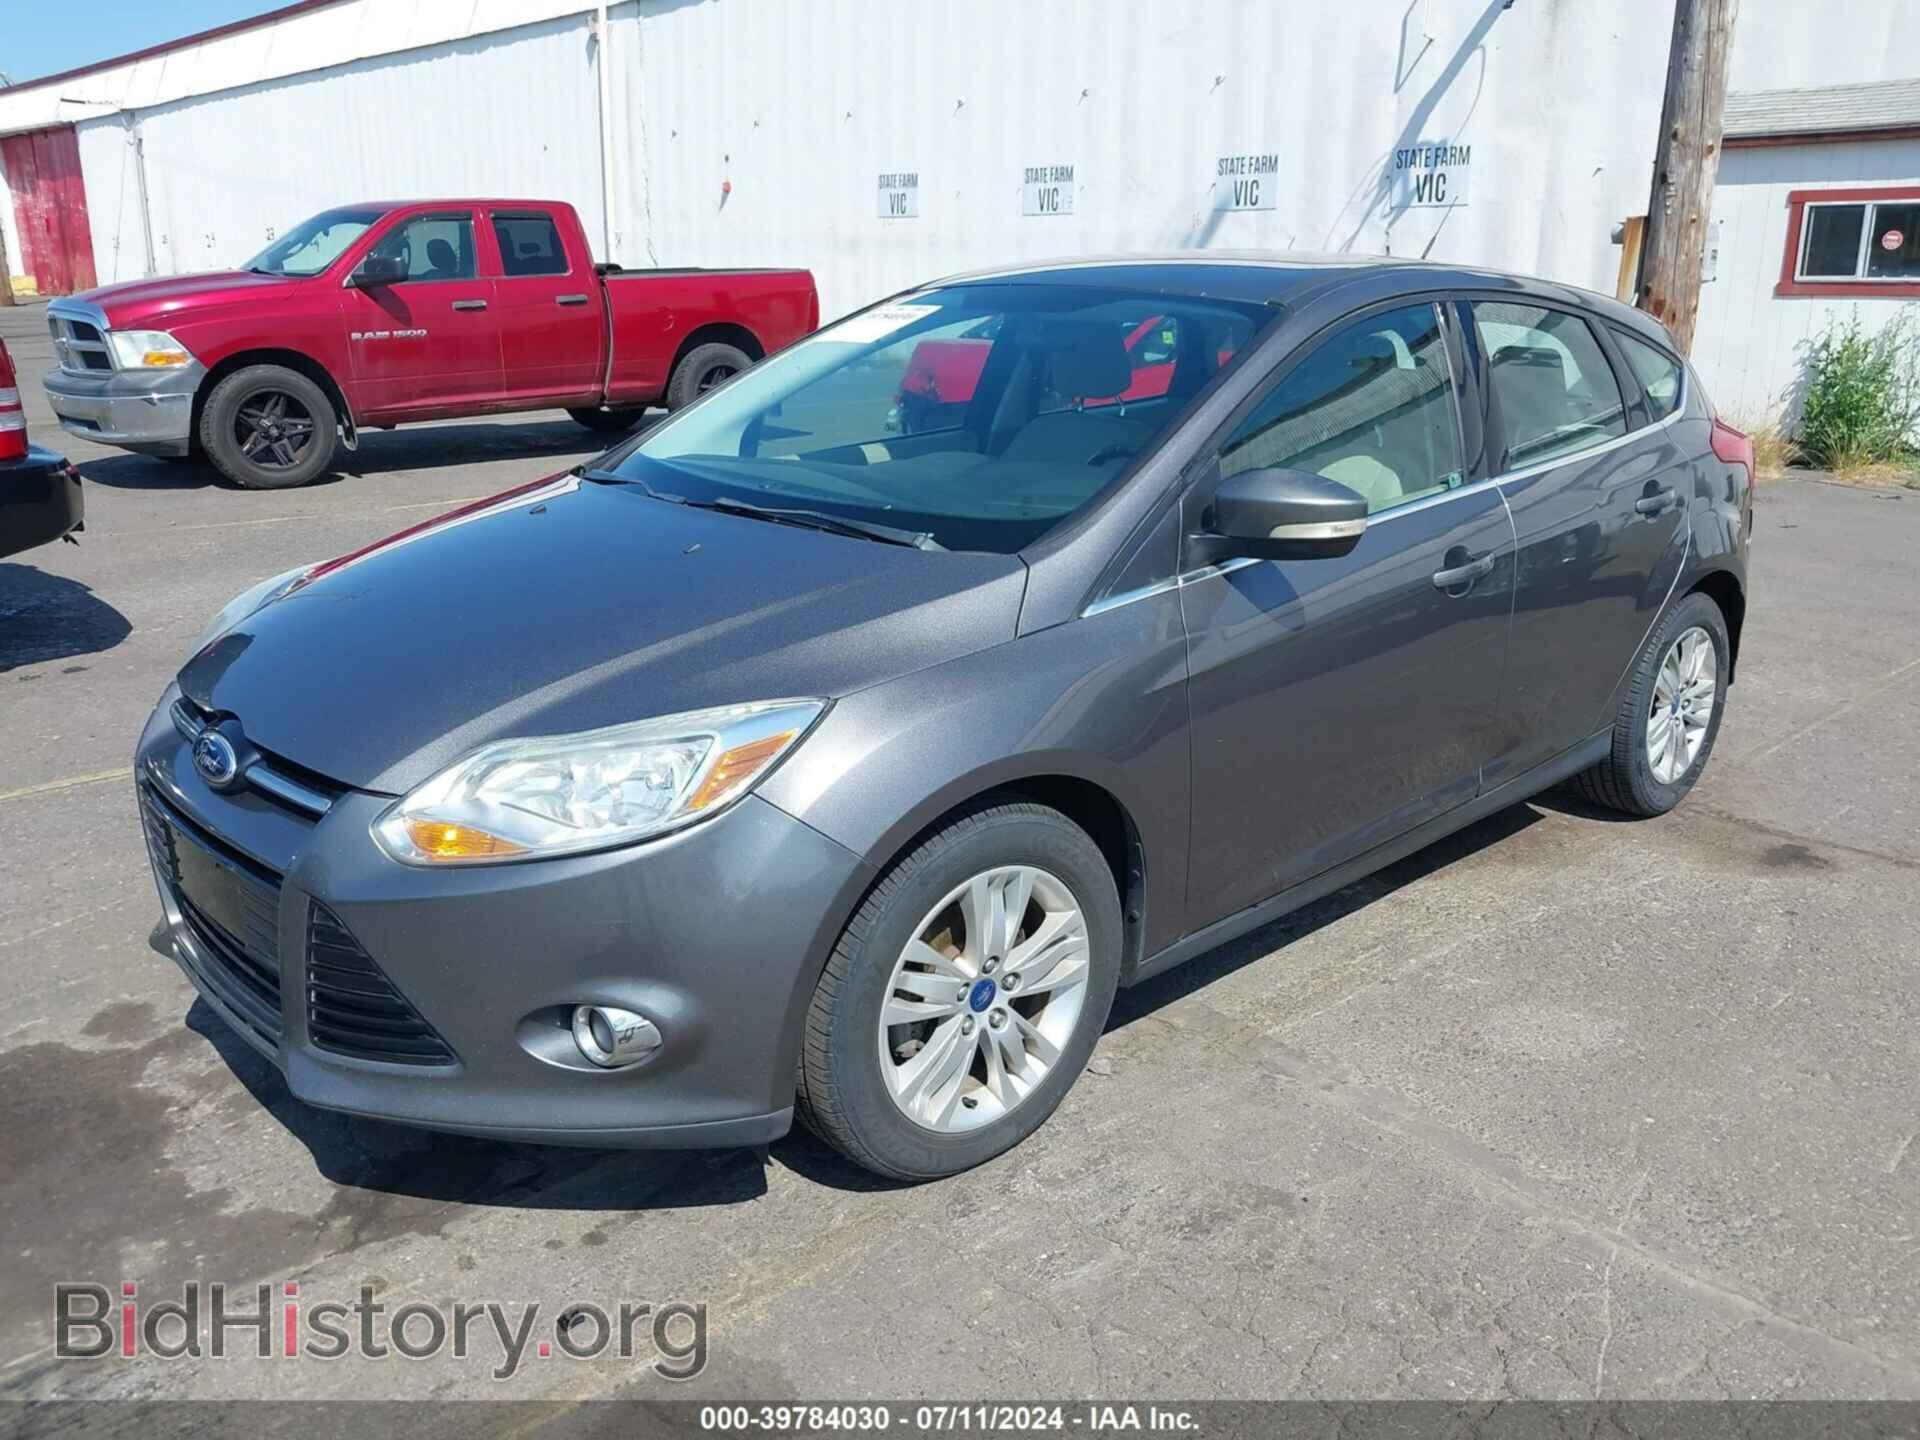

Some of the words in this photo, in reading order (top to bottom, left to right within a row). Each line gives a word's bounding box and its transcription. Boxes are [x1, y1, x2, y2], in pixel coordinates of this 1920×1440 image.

[1218, 156, 1246, 176] STATE
[1249, 154, 1278, 174] FARM
[1396, 148, 1431, 170] STATE
[1434, 145, 1471, 167] FARM
[878, 173, 897, 189] STATE
[898, 172, 918, 188] FARM
[1024, 167, 1048, 184] STATE
[1050, 165, 1074, 183] FARM
[1038, 187, 1060, 212] VIC
[1234, 179, 1260, 207] VIC
[1416, 173, 1446, 203] VIC
[889, 192, 907, 215] VIC
[351, 331, 390, 340] RAM
[393, 328, 427, 338] 1500
[195, 739, 226, 773] Ford
